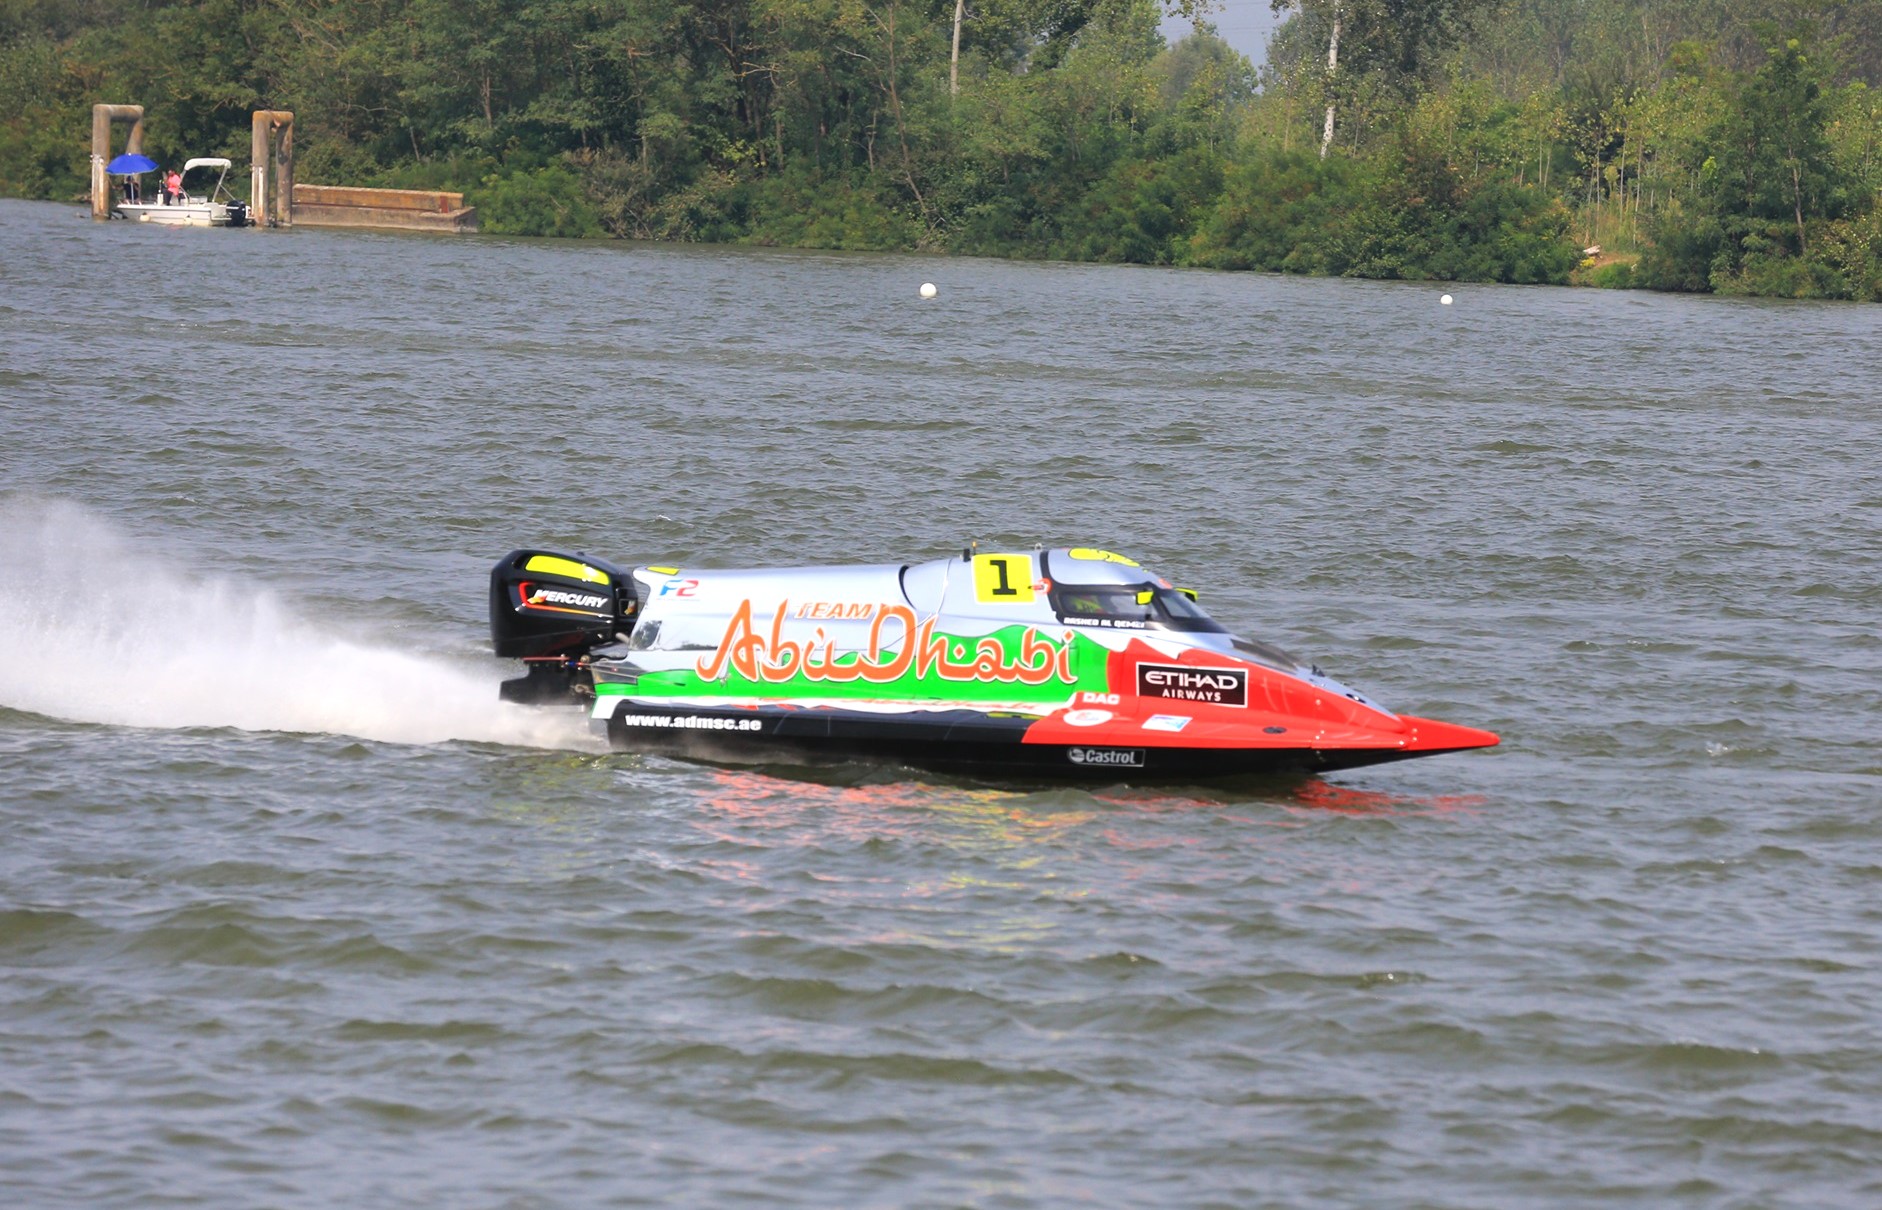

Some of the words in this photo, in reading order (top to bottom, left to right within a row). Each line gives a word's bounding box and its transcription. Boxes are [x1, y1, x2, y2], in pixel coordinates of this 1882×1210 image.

[990, 559, 1017, 596] 1
[659, 579, 699, 597] F2
[533, 589, 608, 608] MERCURY
[796, 602, 873, 619] TEAM
[694, 598, 860, 684] Abu
[860, 601, 1078, 685] Dhabi
[1145, 670, 1238, 690] ETIHAD
[1162, 688, 1221, 702] AIRWAYS
[624, 714, 762, 731] www.admsc.ae
[1085, 749, 1135, 764] Castrol
